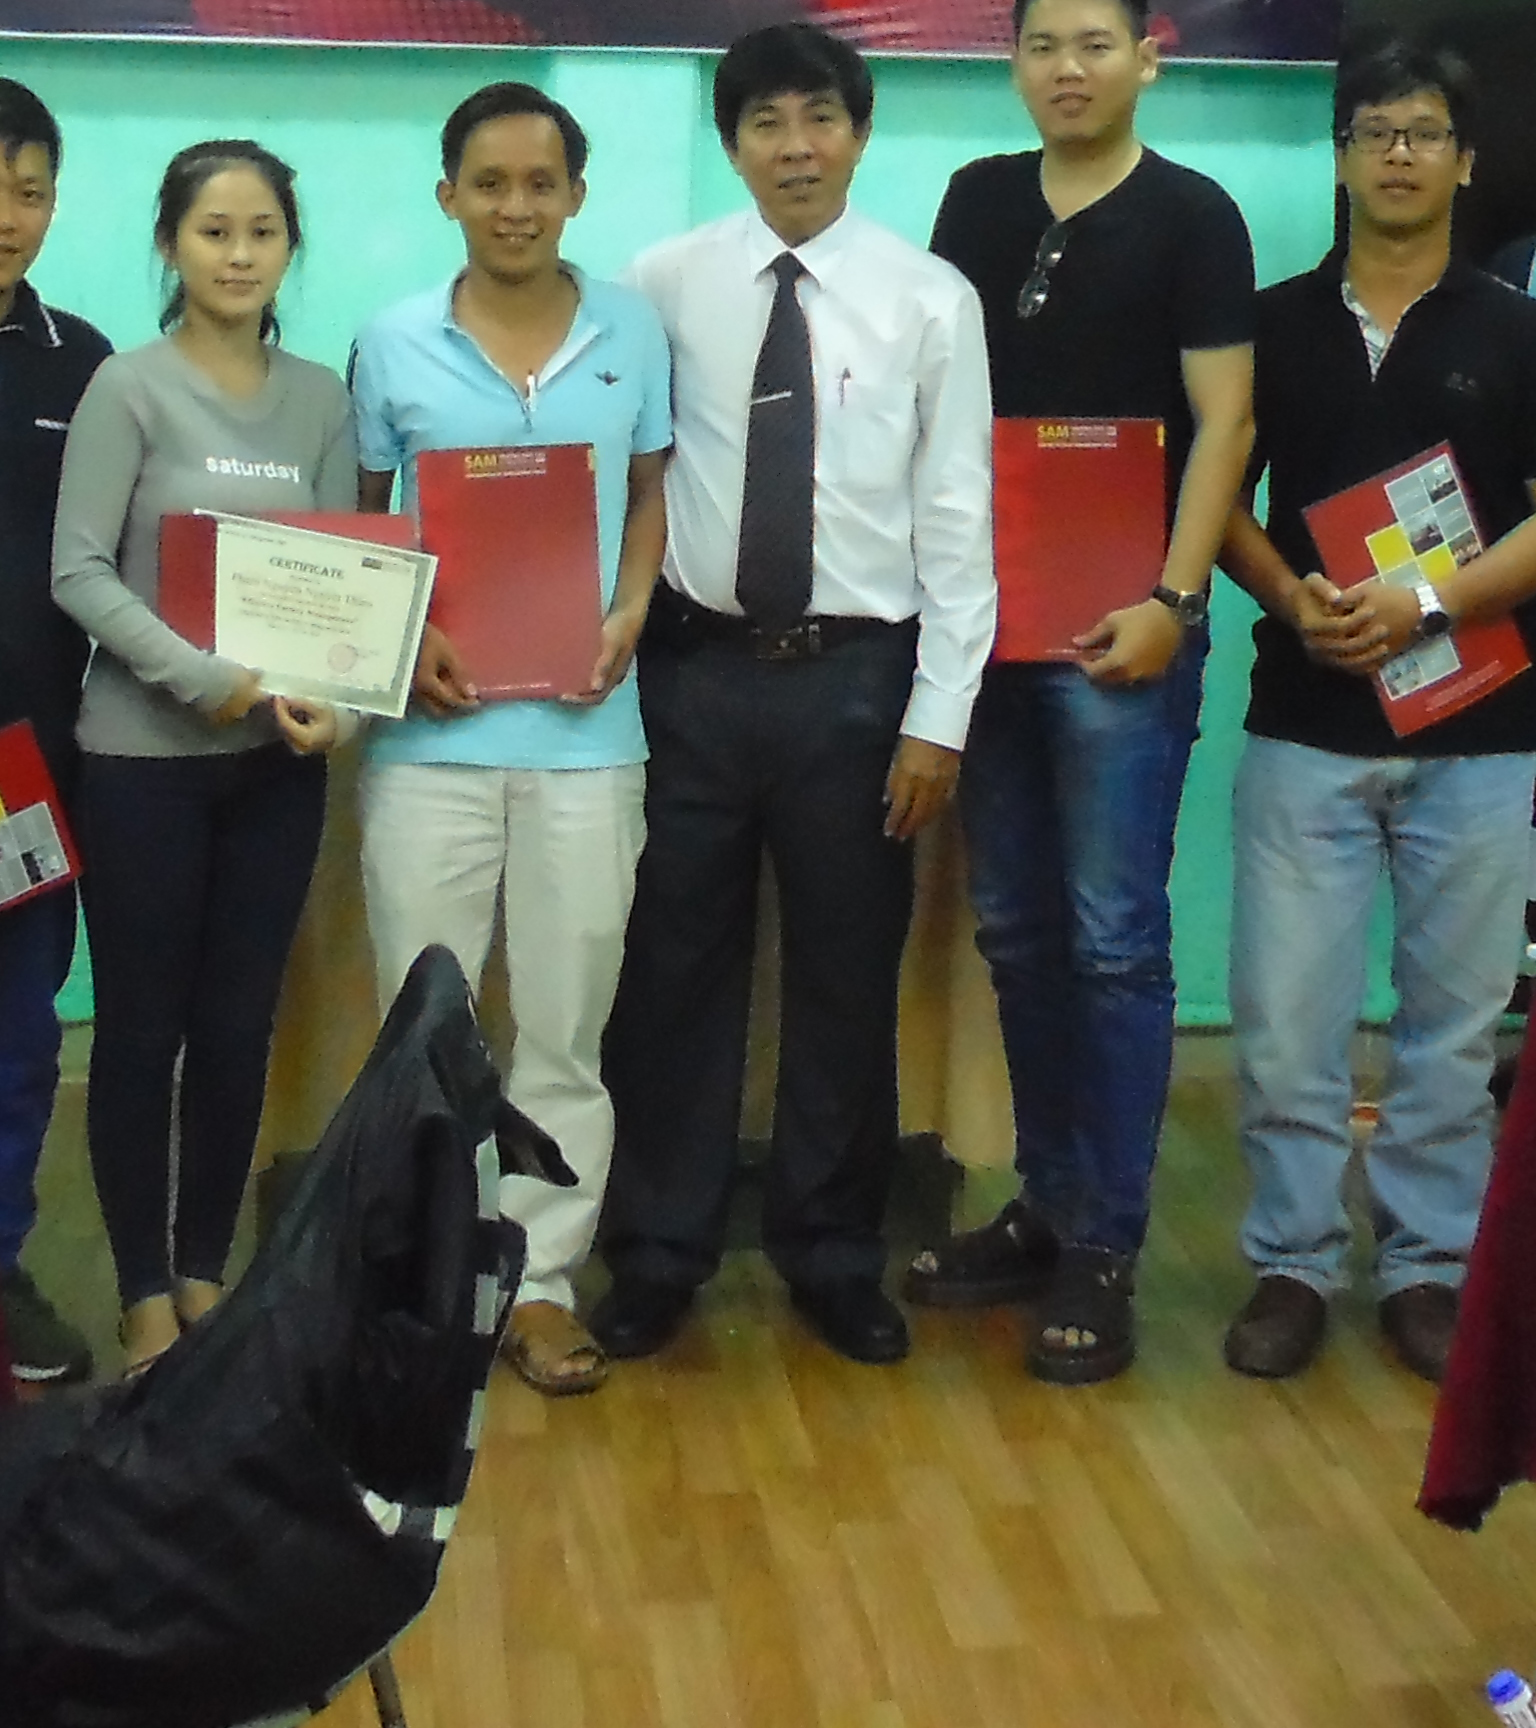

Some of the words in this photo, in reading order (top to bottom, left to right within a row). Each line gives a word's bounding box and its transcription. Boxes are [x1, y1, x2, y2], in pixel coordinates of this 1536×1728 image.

[1037, 424, 1070, 439] SAM
[205, 456, 300, 483] saturday
[465, 454, 498, 469] SAM
[268, 555, 346, 580] CERTIFICATE
